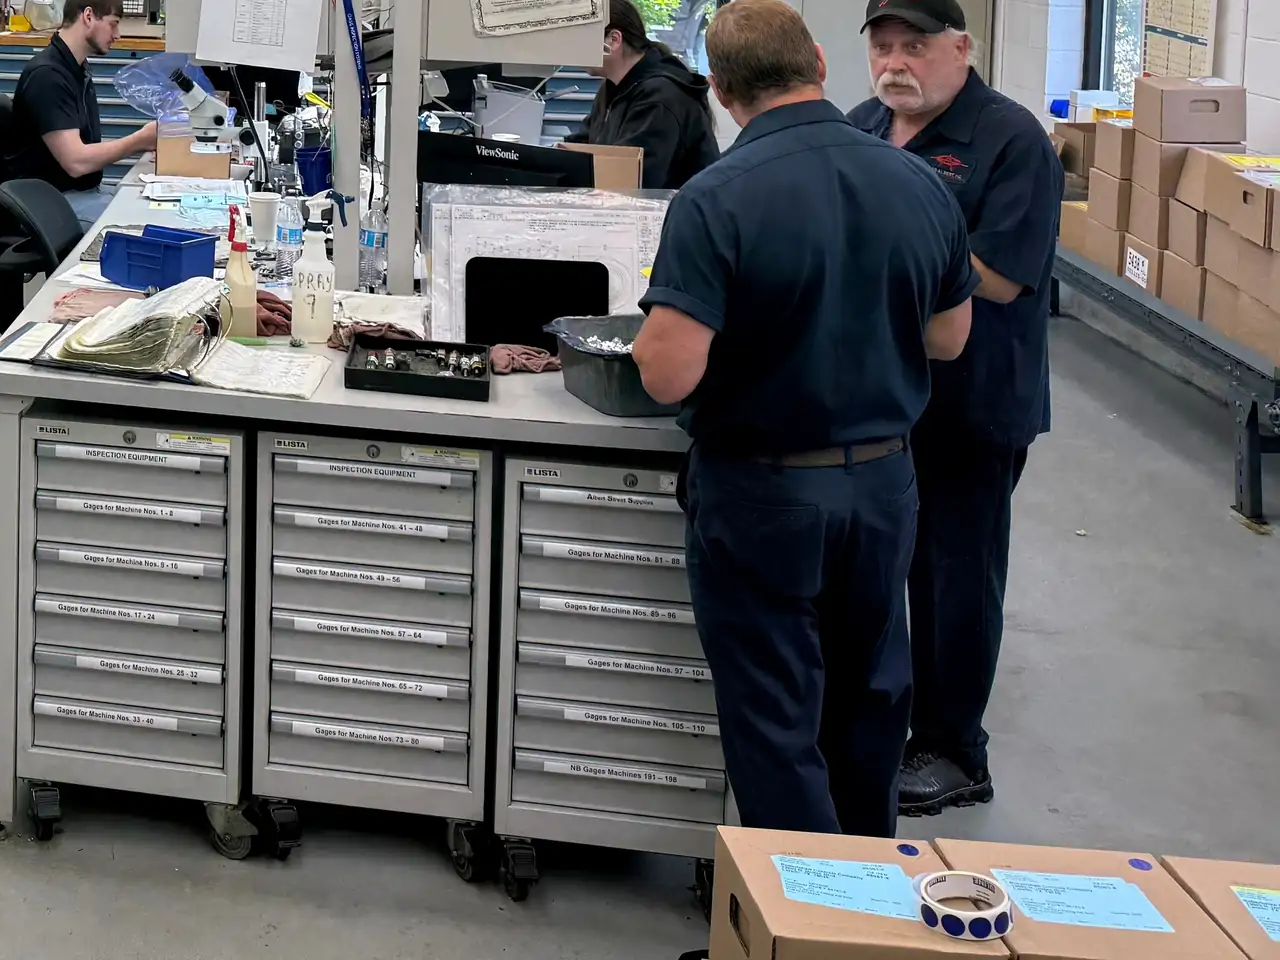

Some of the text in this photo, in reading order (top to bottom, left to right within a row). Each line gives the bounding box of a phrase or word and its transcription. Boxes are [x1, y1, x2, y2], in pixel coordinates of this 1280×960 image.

[476, 145, 519, 160] ViewSonic
[86, 450, 167, 463] INSPECTION EQUIPMENT
[329, 464, 416, 478] INSPECTION EQUIPMENT
[533, 468, 558, 478] LISTA
[84, 502, 103, 511] Gages
[116, 505, 142, 513] Machine
[318, 517, 339, 527] Gages
[352, 520, 380, 529] Machine
[116, 557, 142, 566] Machine
[568, 549, 590, 558] Gages
[605, 552, 634, 561] Machine
[296, 567, 317, 577] Gages
[330, 570, 358, 579] Machine
[58, 604, 78, 612] Gages
[90, 607, 116, 616] Machine
[564, 602, 587, 611] Gages
[601, 606, 630, 615] Machine
[632, 609, 648, 617] Nos.
[317, 623, 338, 633] Gages
[351, 626, 379, 635] Machine
[100, 660, 120, 669] Gages
[132, 664, 158, 674] Machine
[588, 659, 611, 669] Gages
[624, 662, 655, 672] Machine
[656, 665, 672, 674] Nos.
[318, 674, 339, 684] Gages
[352, 677, 380, 687] Machine
[382, 680, 397, 689] Nos.
[57, 706, 76, 715] Gages
[89, 710, 115, 720] Machine
[584, 712, 607, 722] Gages
[621, 716, 651, 726] Machine
[653, 720, 669, 728] Nos.
[315, 727, 336, 737] Gages
[349, 731, 377, 740] Machine
[379, 734, 394, 742] Nos.
[583, 765, 606, 776] Gages
[608, 768, 642, 779] Machines
